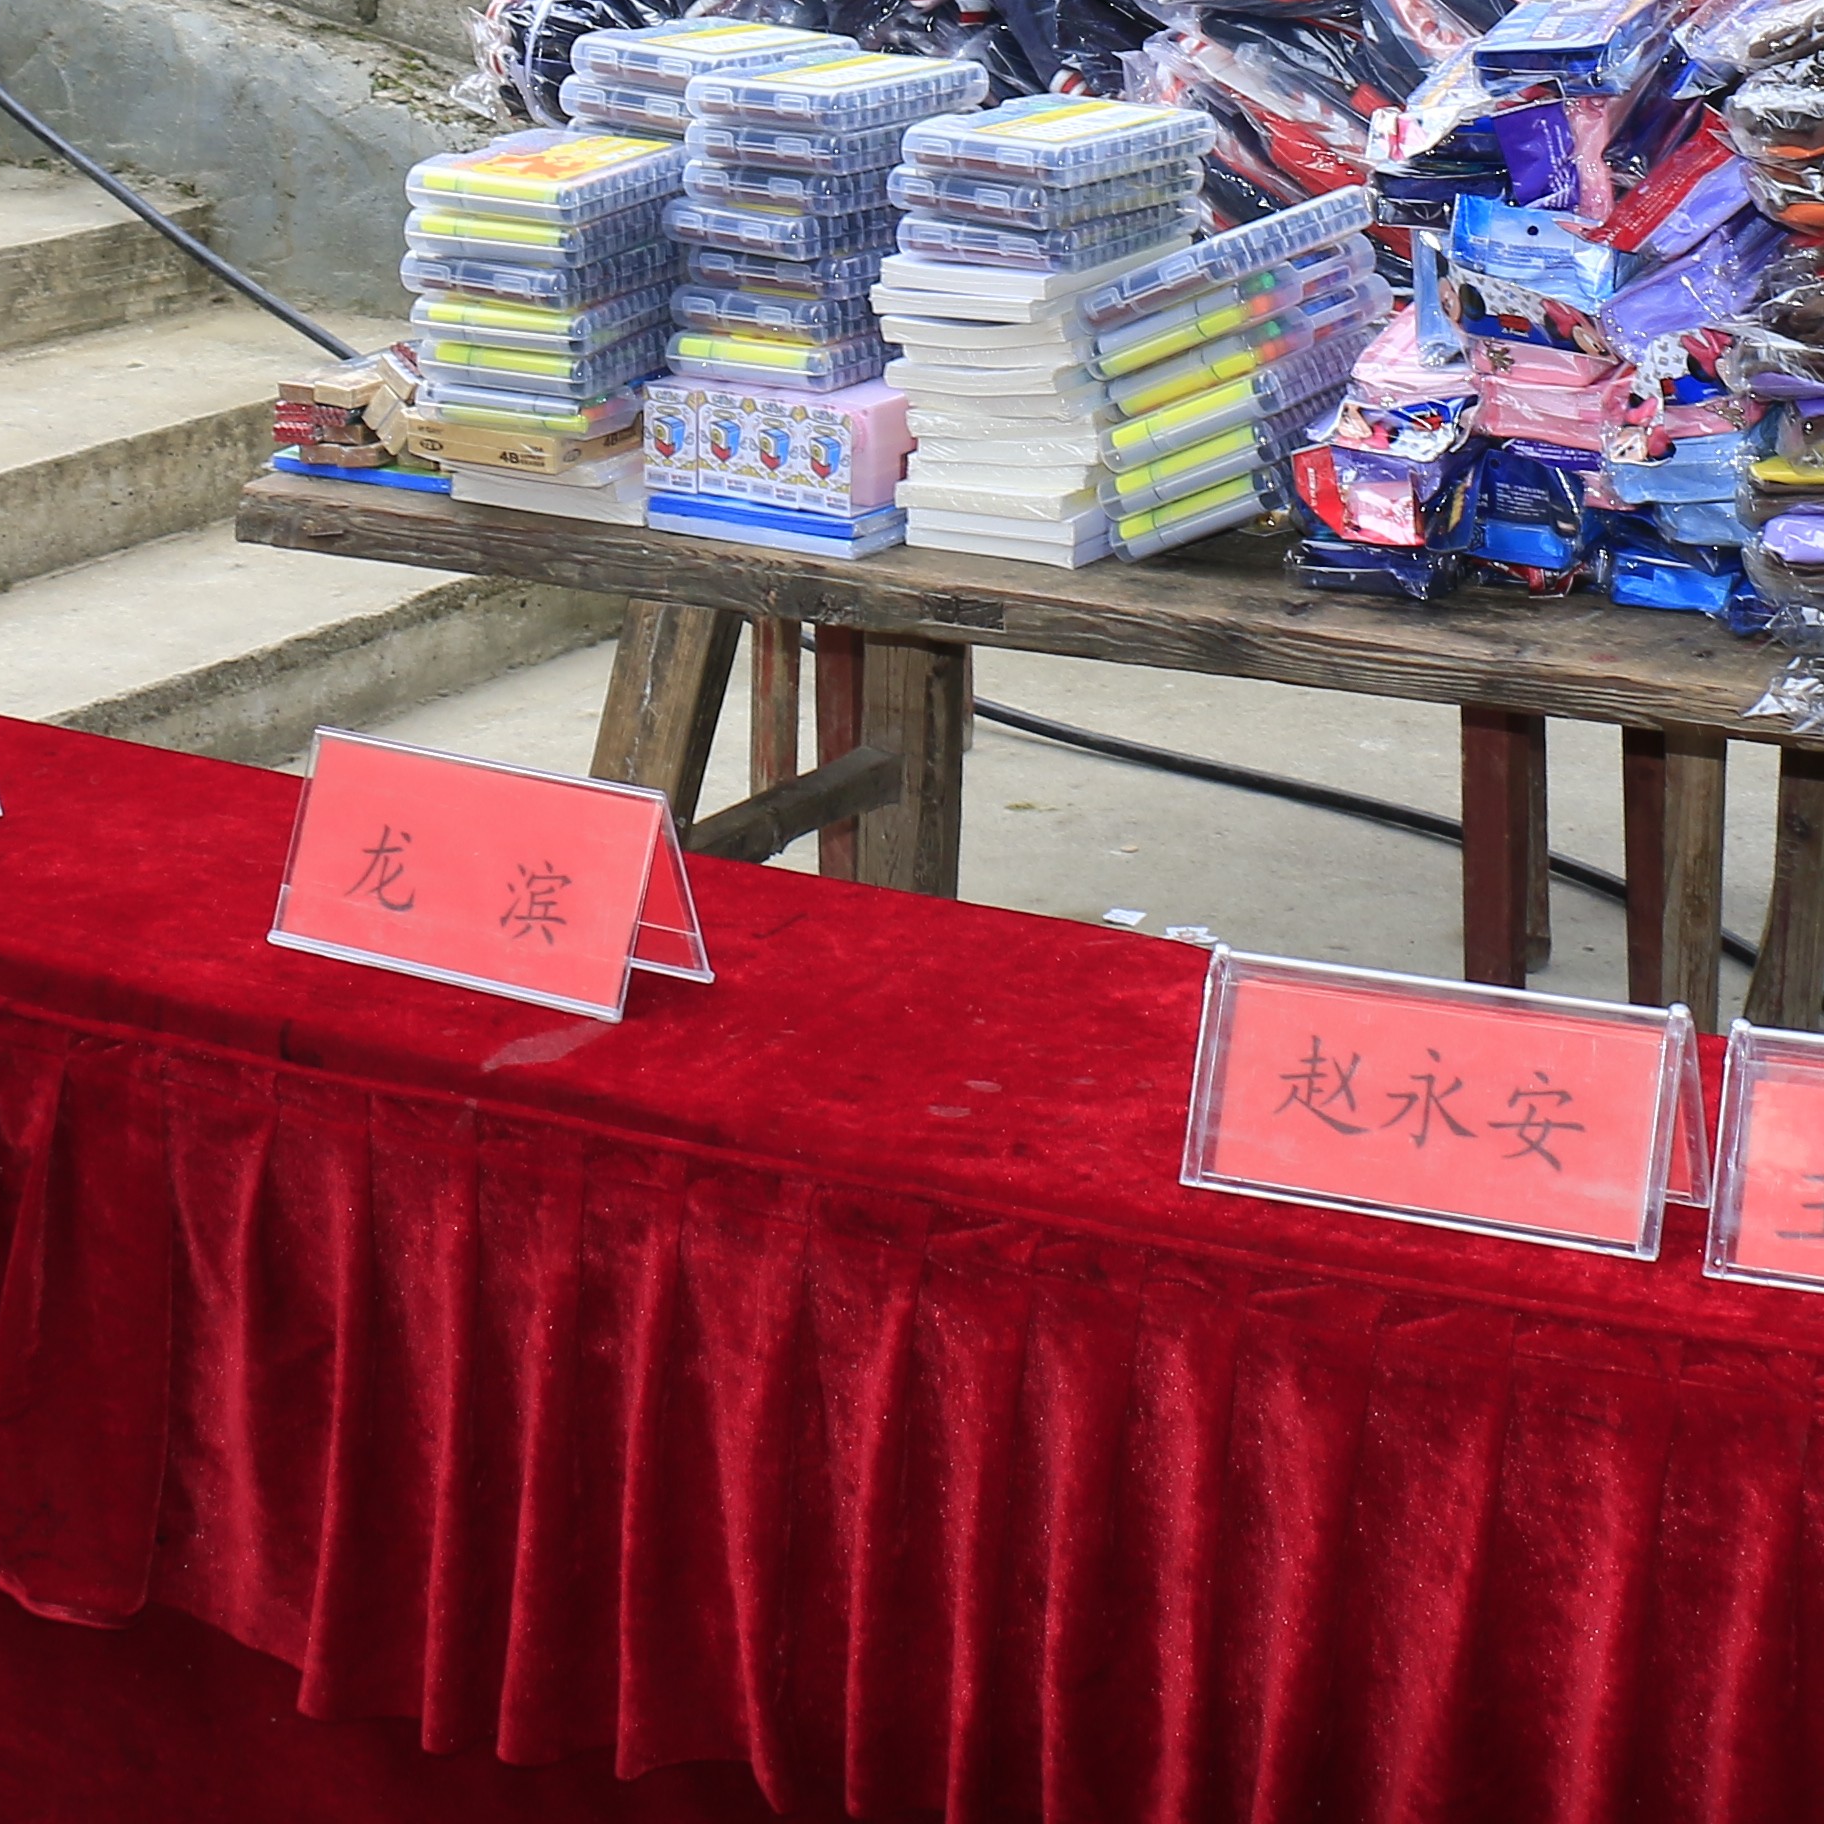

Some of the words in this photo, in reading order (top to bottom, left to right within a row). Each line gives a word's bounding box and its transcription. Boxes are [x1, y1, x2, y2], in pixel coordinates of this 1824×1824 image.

[499, 451, 520, 464] 4B
[1273, 1034, 1586, 1171] 赵永安
